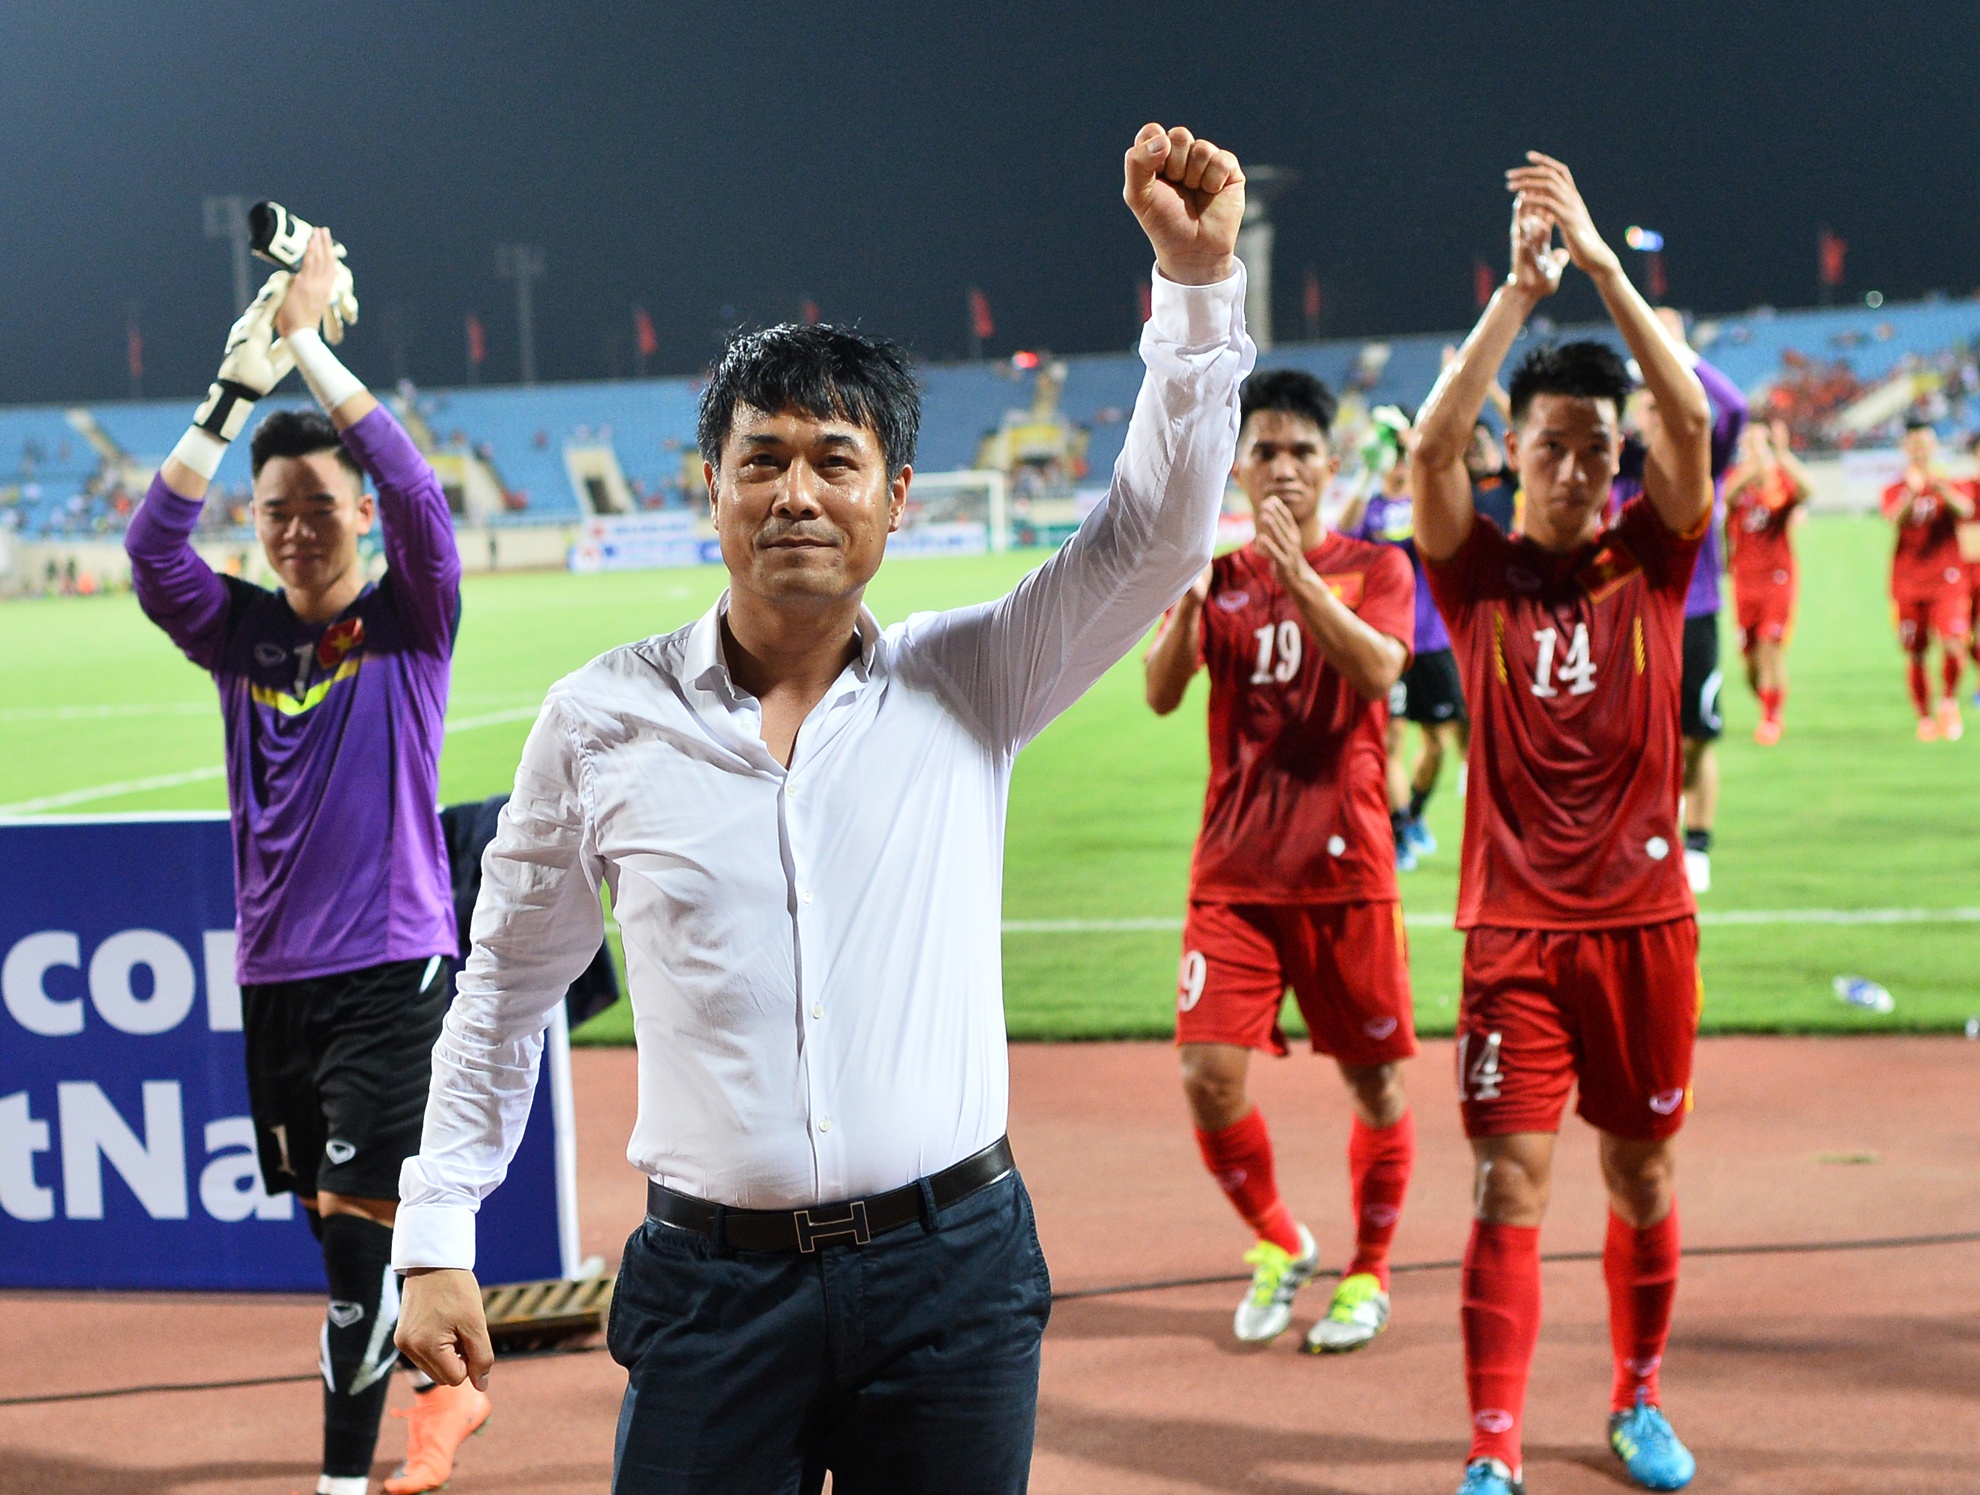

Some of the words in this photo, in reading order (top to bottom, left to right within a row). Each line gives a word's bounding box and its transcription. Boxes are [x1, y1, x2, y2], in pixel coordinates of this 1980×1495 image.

[1249, 619, 1302, 686] 19
[1530, 621, 1598, 699] 14
[1, 928, 244, 1036] co
[270, 1124, 296, 1176] 1
